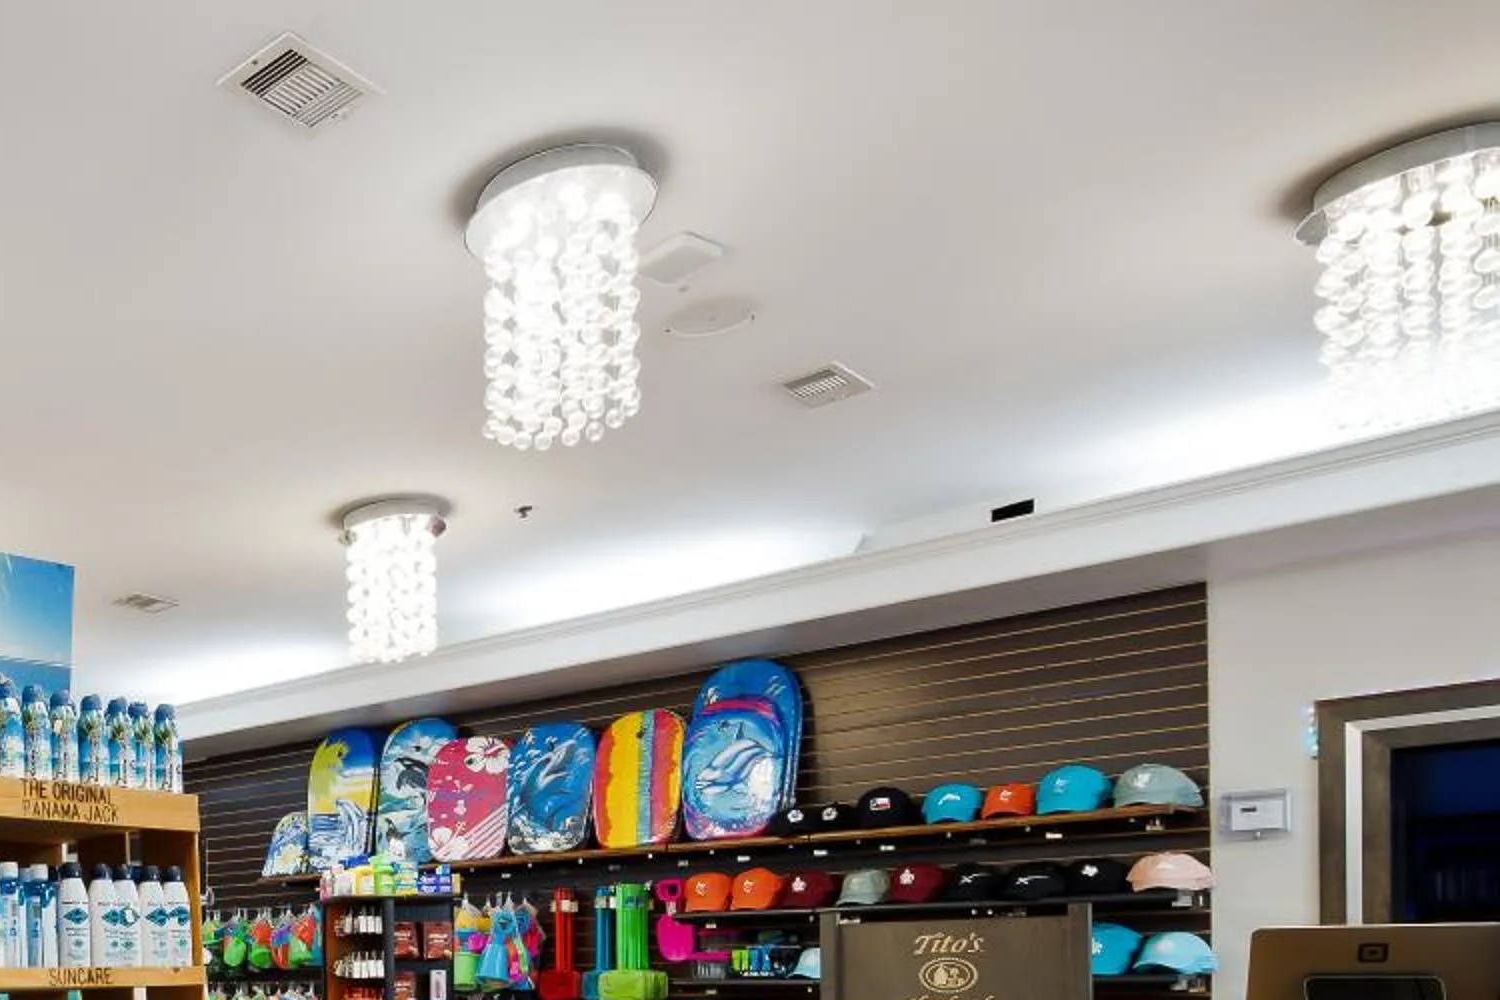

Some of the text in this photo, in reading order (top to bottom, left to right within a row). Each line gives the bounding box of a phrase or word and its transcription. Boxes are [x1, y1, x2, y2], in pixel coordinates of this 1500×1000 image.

[20, 777, 113, 805] THE ORIGINAL
[21, 799, 119, 823] PANAMA JACK
[914, 932, 985, 955] Tito's
